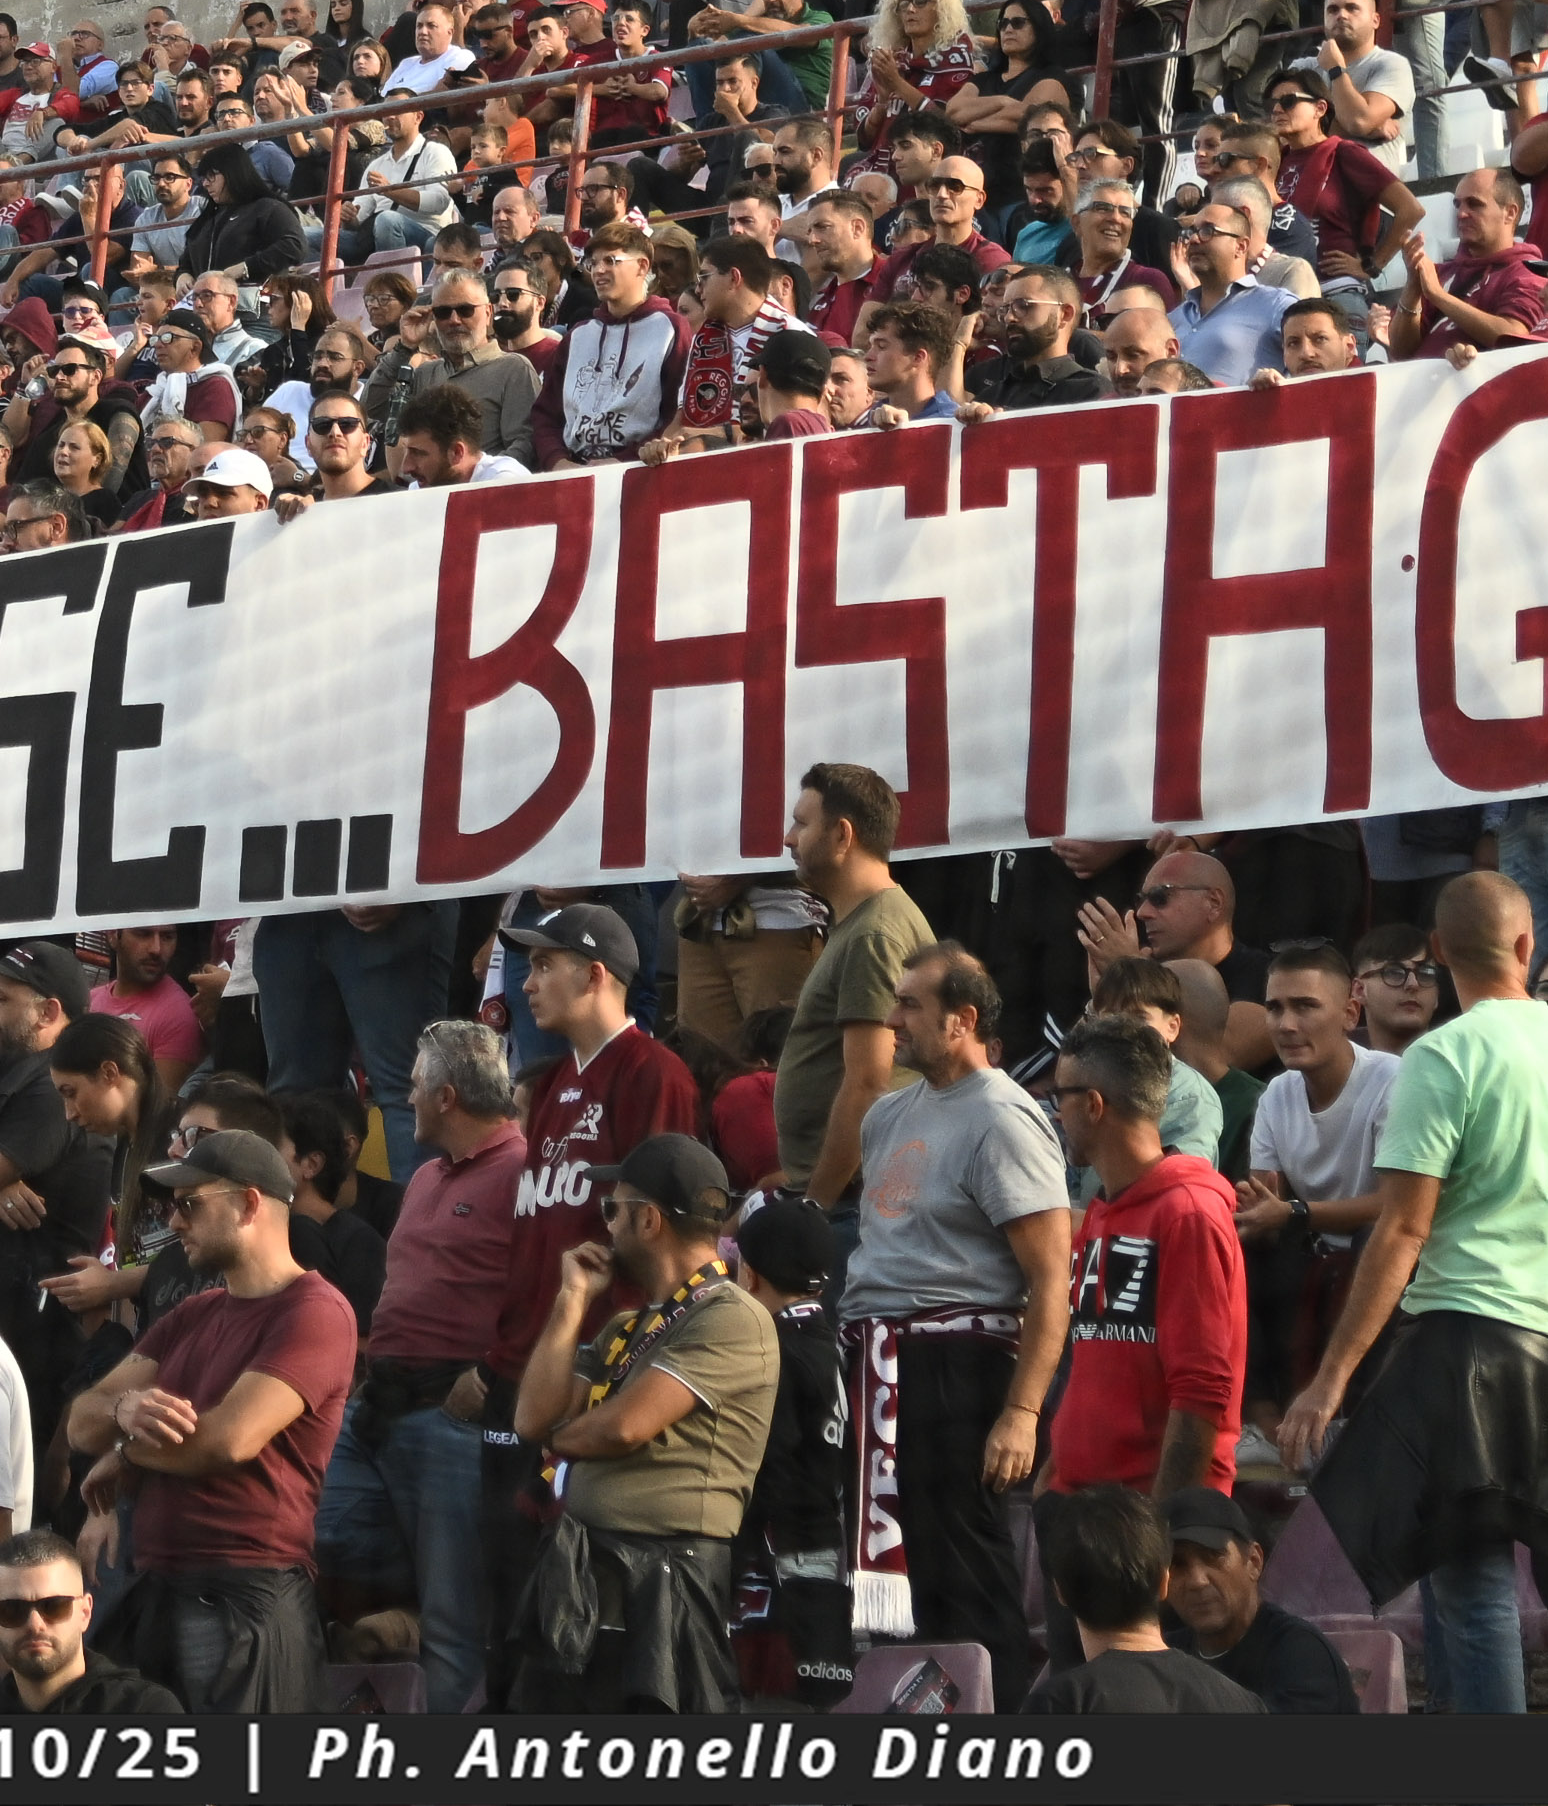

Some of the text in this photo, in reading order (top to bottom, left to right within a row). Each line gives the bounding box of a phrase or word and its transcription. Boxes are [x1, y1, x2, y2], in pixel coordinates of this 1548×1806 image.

[415, 370, 1376, 885] BASTA
[483, 1429, 520, 1445] LEGEA
[797, 1662, 854, 1681] adidas
